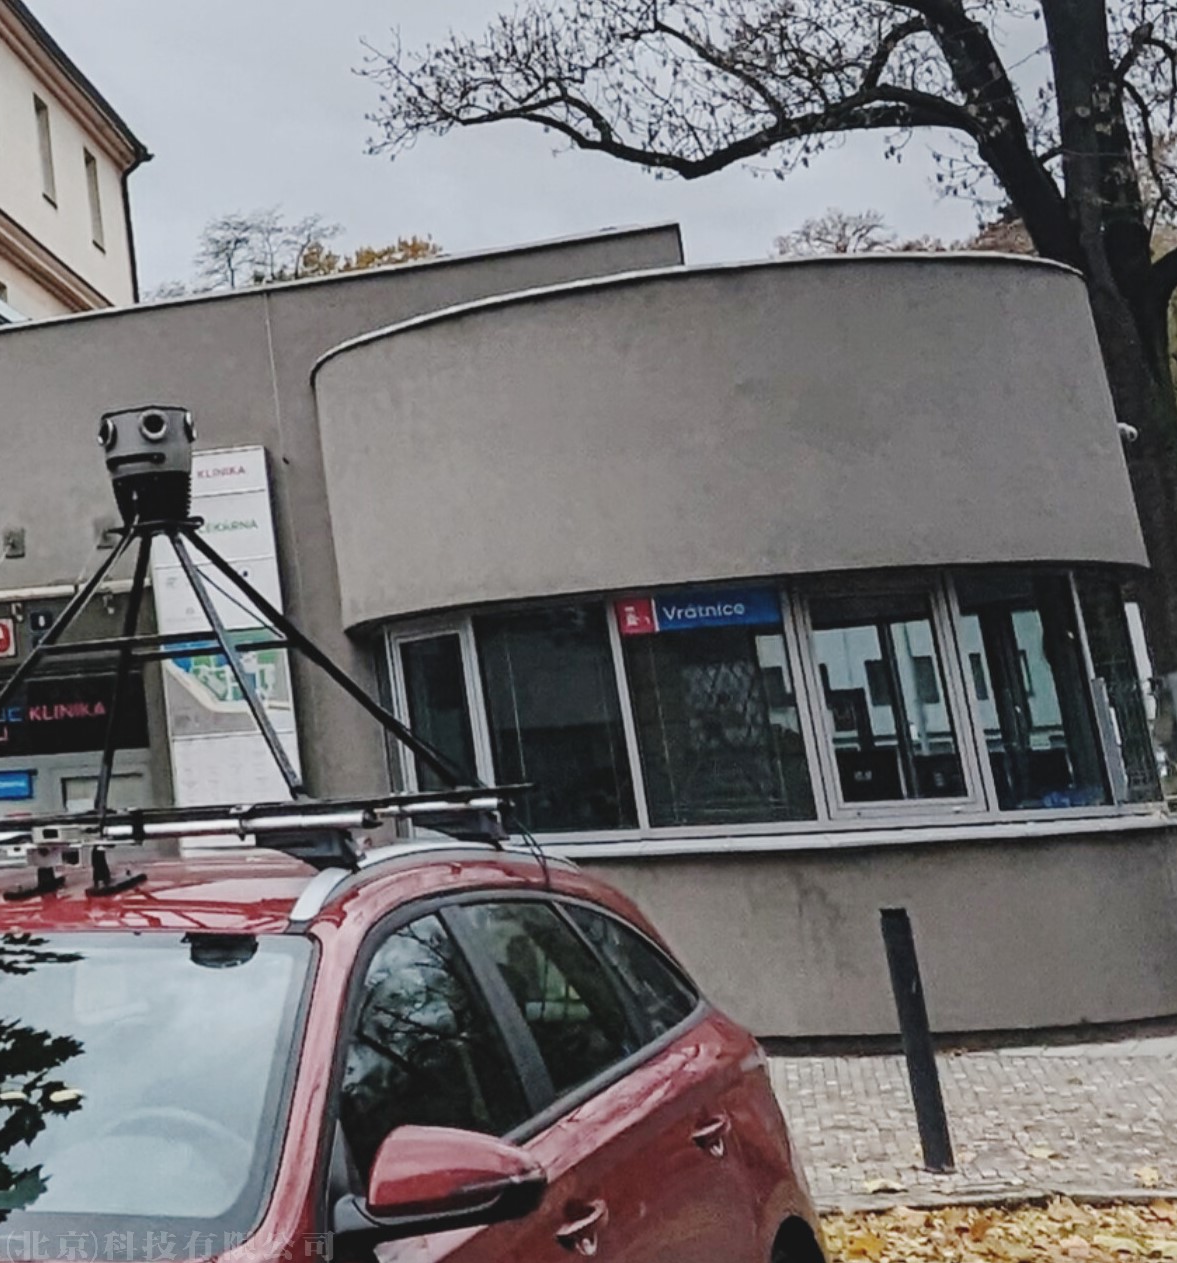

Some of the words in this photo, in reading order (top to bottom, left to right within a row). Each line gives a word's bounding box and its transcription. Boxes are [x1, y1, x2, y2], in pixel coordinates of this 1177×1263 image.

[197, 466, 246, 479] KLINIKA
[662, 602, 746, 621] Vrátnice
[29, 701, 106, 721] KLINIKA
